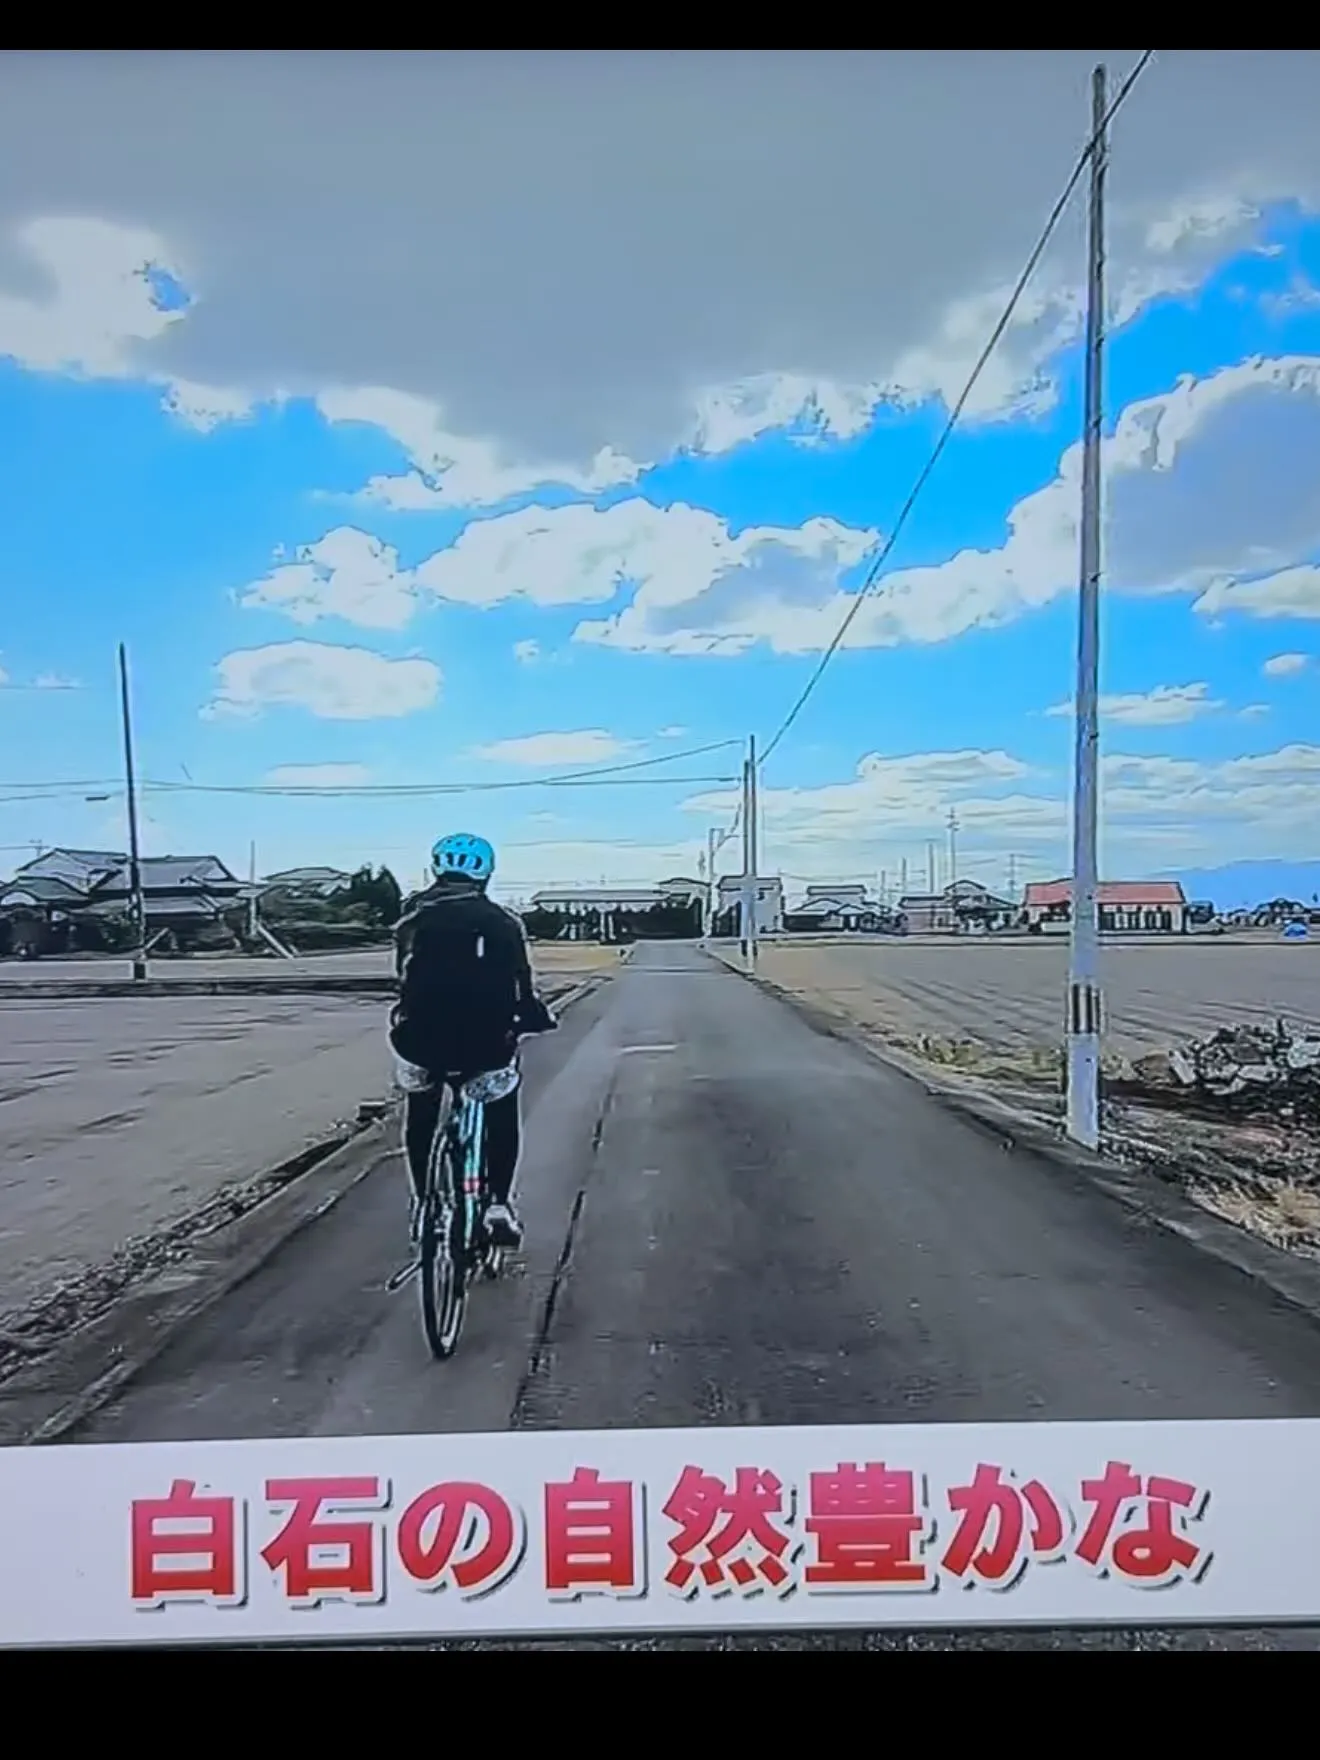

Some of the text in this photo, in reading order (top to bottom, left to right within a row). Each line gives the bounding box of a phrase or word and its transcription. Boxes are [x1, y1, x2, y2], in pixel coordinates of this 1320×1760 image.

[130, 1461, 1208, 1603] 白石の自然豊かな
